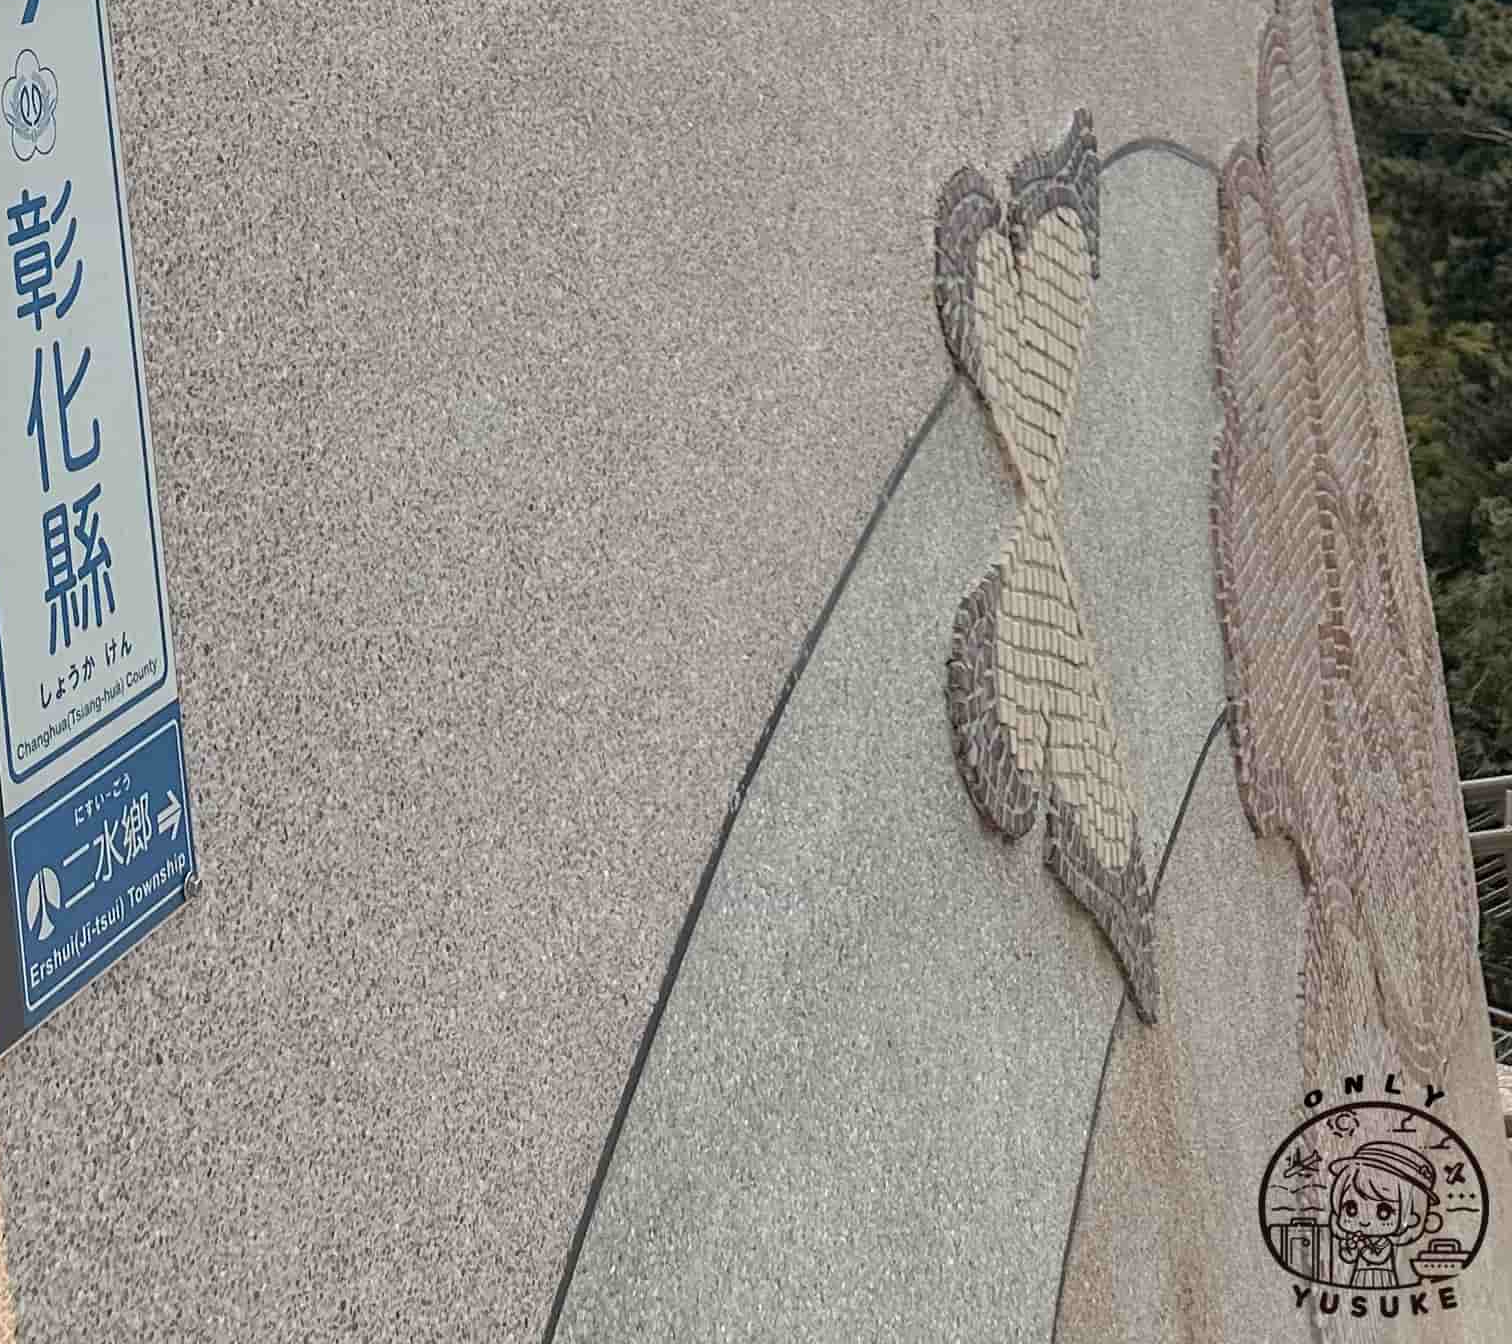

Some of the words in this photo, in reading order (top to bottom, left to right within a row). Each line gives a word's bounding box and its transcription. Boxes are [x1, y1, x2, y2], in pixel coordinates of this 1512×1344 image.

[6, 178, 116, 656] 彰化縣
[126, 658, 159, 689] County
[127, 851, 187, 909] Township
